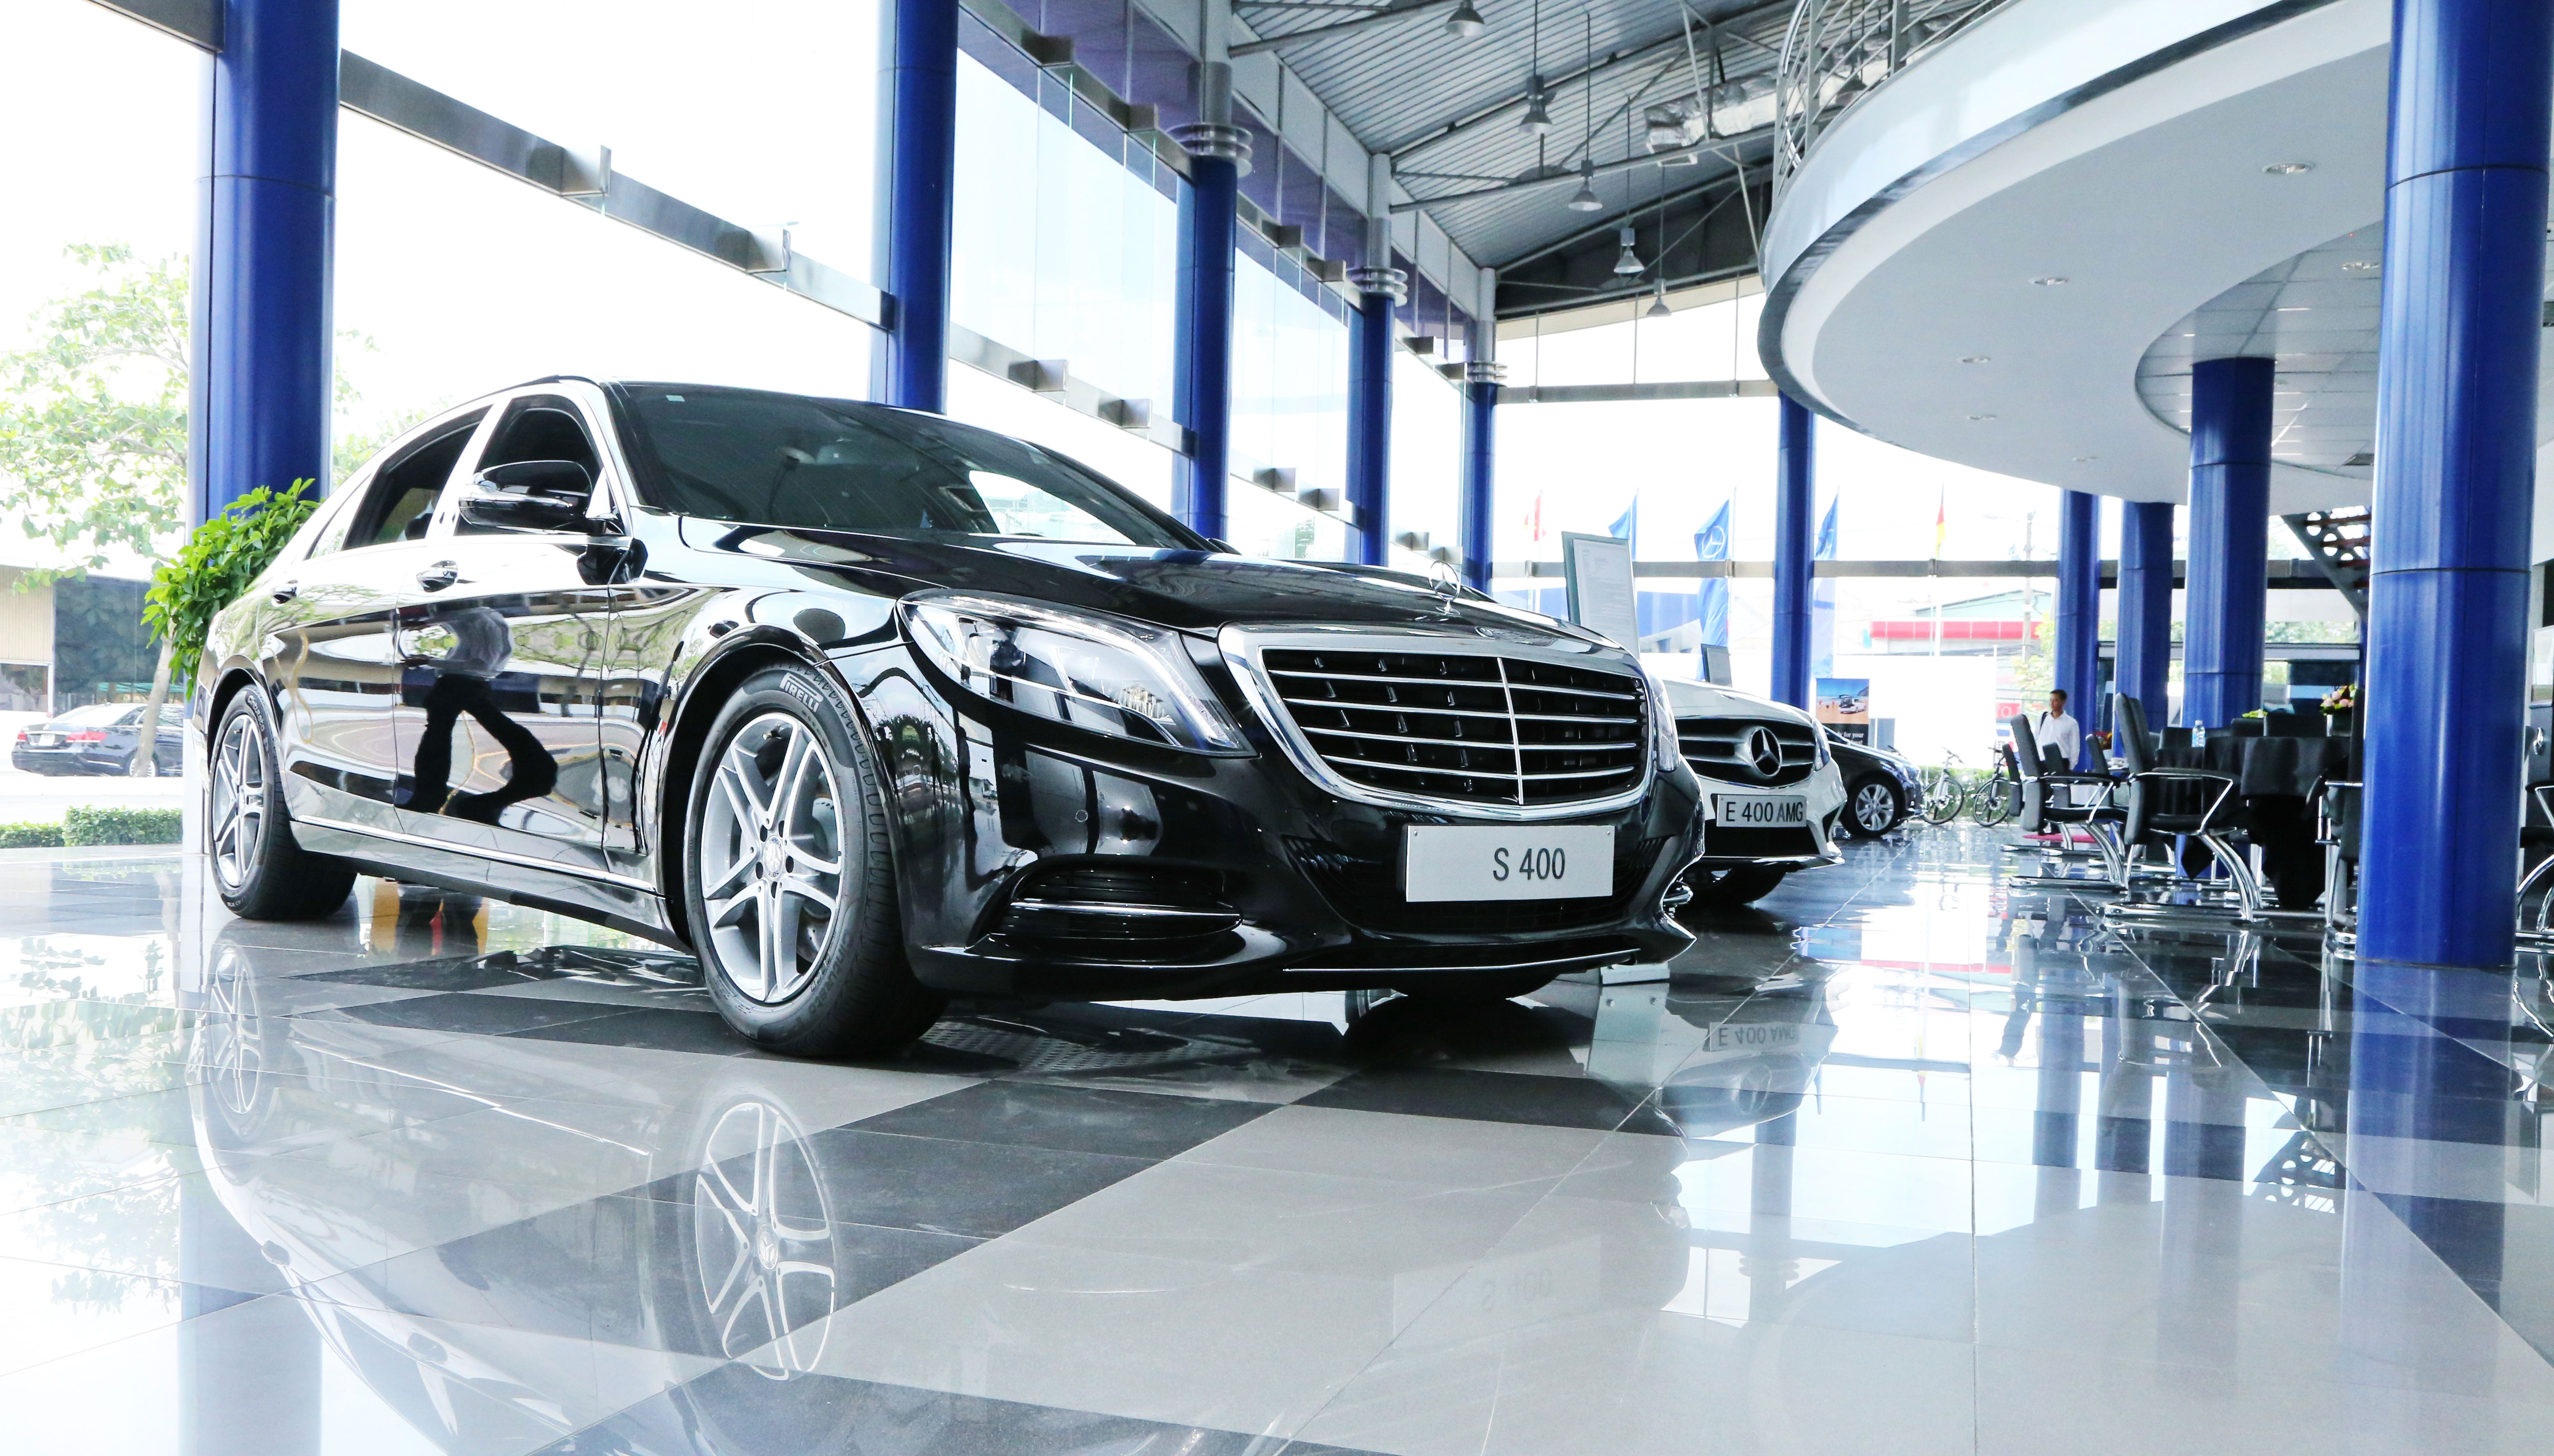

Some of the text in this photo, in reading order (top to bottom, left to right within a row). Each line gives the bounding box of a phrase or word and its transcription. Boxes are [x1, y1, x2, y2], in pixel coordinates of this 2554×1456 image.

[779, 672, 824, 713] PIRELLI
[1726, 801, 1803, 822] E 400 AMG
[1493, 847, 1565, 881] S 400
